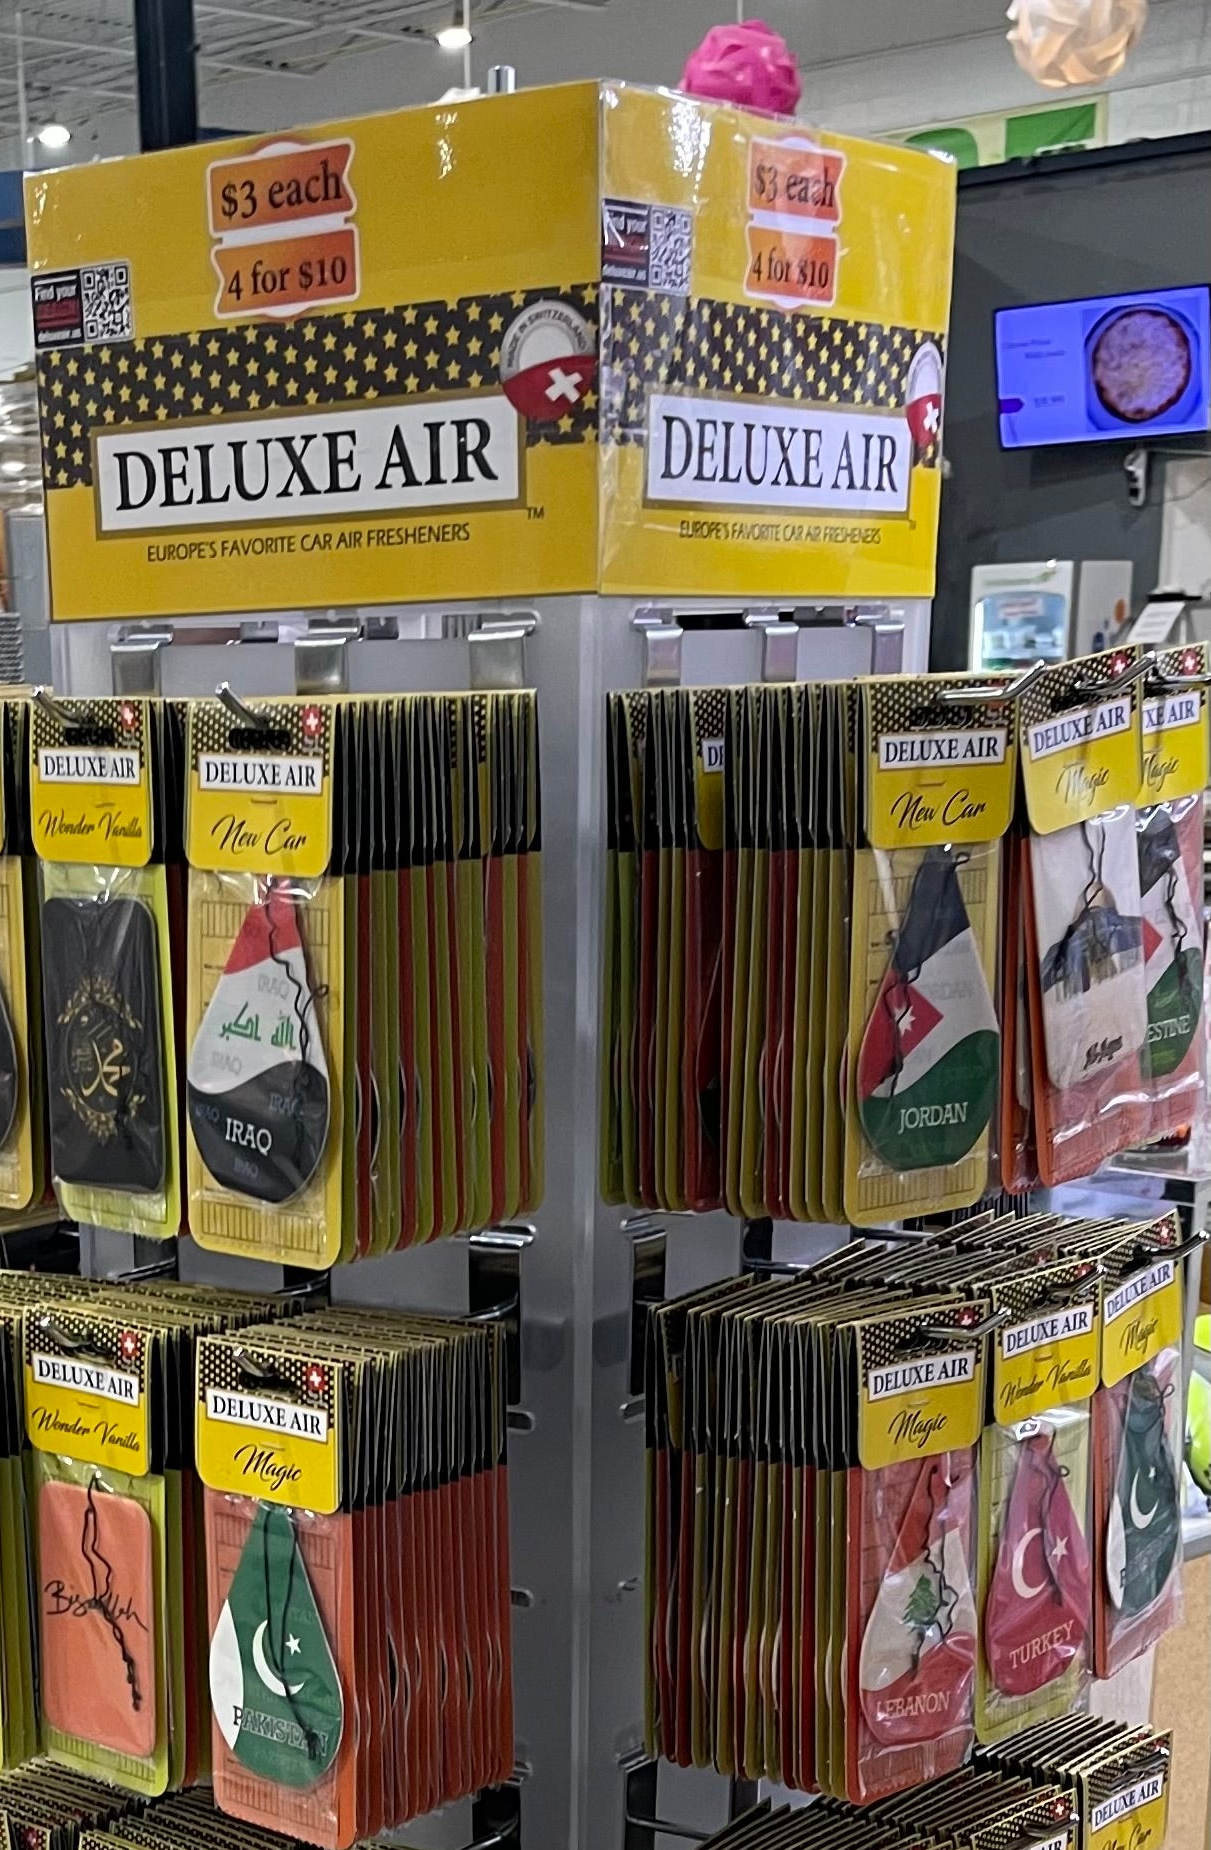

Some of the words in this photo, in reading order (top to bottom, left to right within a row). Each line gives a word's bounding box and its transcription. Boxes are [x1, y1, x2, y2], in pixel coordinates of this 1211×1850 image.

[221, 181, 258, 218] $3
[268, 161, 343, 208] each
[755, 163, 777, 203] $3
[785, 167, 834, 207] each
[228, 273, 242, 301] 4
[251, 262, 290, 295] for
[299, 256, 347, 291] $10
[752, 250, 762, 280] 4
[767, 251, 792, 283] for
[797, 259, 829, 288] $10
[113, 430, 359, 511] DELUXE
[375, 417, 498, 490] AIR
[661, 415, 822, 489] DELUXE
[832, 432, 898, 492] AIR
[147, 540, 217, 563] EUROPE'S
[221, 535, 296, 558] FAVORITE
[300, 532, 333, 553] CAR
[336, 530, 362, 550] AIR
[366, 523, 469, 547] FRESHENERS
[679, 520, 729, 539] EUROPE'S
[731, 522, 781, 541] FAVORITE
[783, 525, 804, 541] CAR
[806, 526, 821, 542] AIR
[1034, 712, 1093, 753] DELUXE
[1096, 705, 1126, 731] AIR
[1167, 700, 1195, 723] AIR
[44, 755, 107, 778] DELUXE
[110, 758, 136, 778] AIR
[884, 737, 960, 763] DELUXE
[965, 736, 999, 758] AIR
[205, 762, 281, 786] DELUXE
[285, 763, 316, 787] AIR
[38, 809, 95, 836] Wonder
[890, 791, 937, 829] New
[941, 788, 987, 826] Car
[211, 814, 260, 854] New
[265, 818, 306, 855] Car
[226, 1118, 272, 1156] IRAQ
[898, 1101, 968, 1134] JORDAN
[1149, 1263, 1171, 1288] AIR
[1006, 1324, 1058, 1353] DELUXE
[1061, 1311, 1088, 1333] AIR
[38, 1359, 105, 1391] DELUXE
[108, 1376, 135, 1400] AIR
[873, 1363, 935, 1395] DELUXE
[936, 1357, 968, 1379] AIR
[31, 1406, 90, 1437] Wonder
[93, 1420, 140, 1452] Vanilla
[213, 1396, 287, 1427] DELUXE
[290, 1412, 322, 1435] AIR
[887, 1410, 948, 1449] Magic
[233, 1444, 302, 1491] Magic
[1009, 1619, 1075, 1670] TURKEY
[876, 1690, 952, 1722] LEBANON
[1094, 1790, 1137, 1827] DELUXE
[1137, 1779, 1160, 1801] AIR
